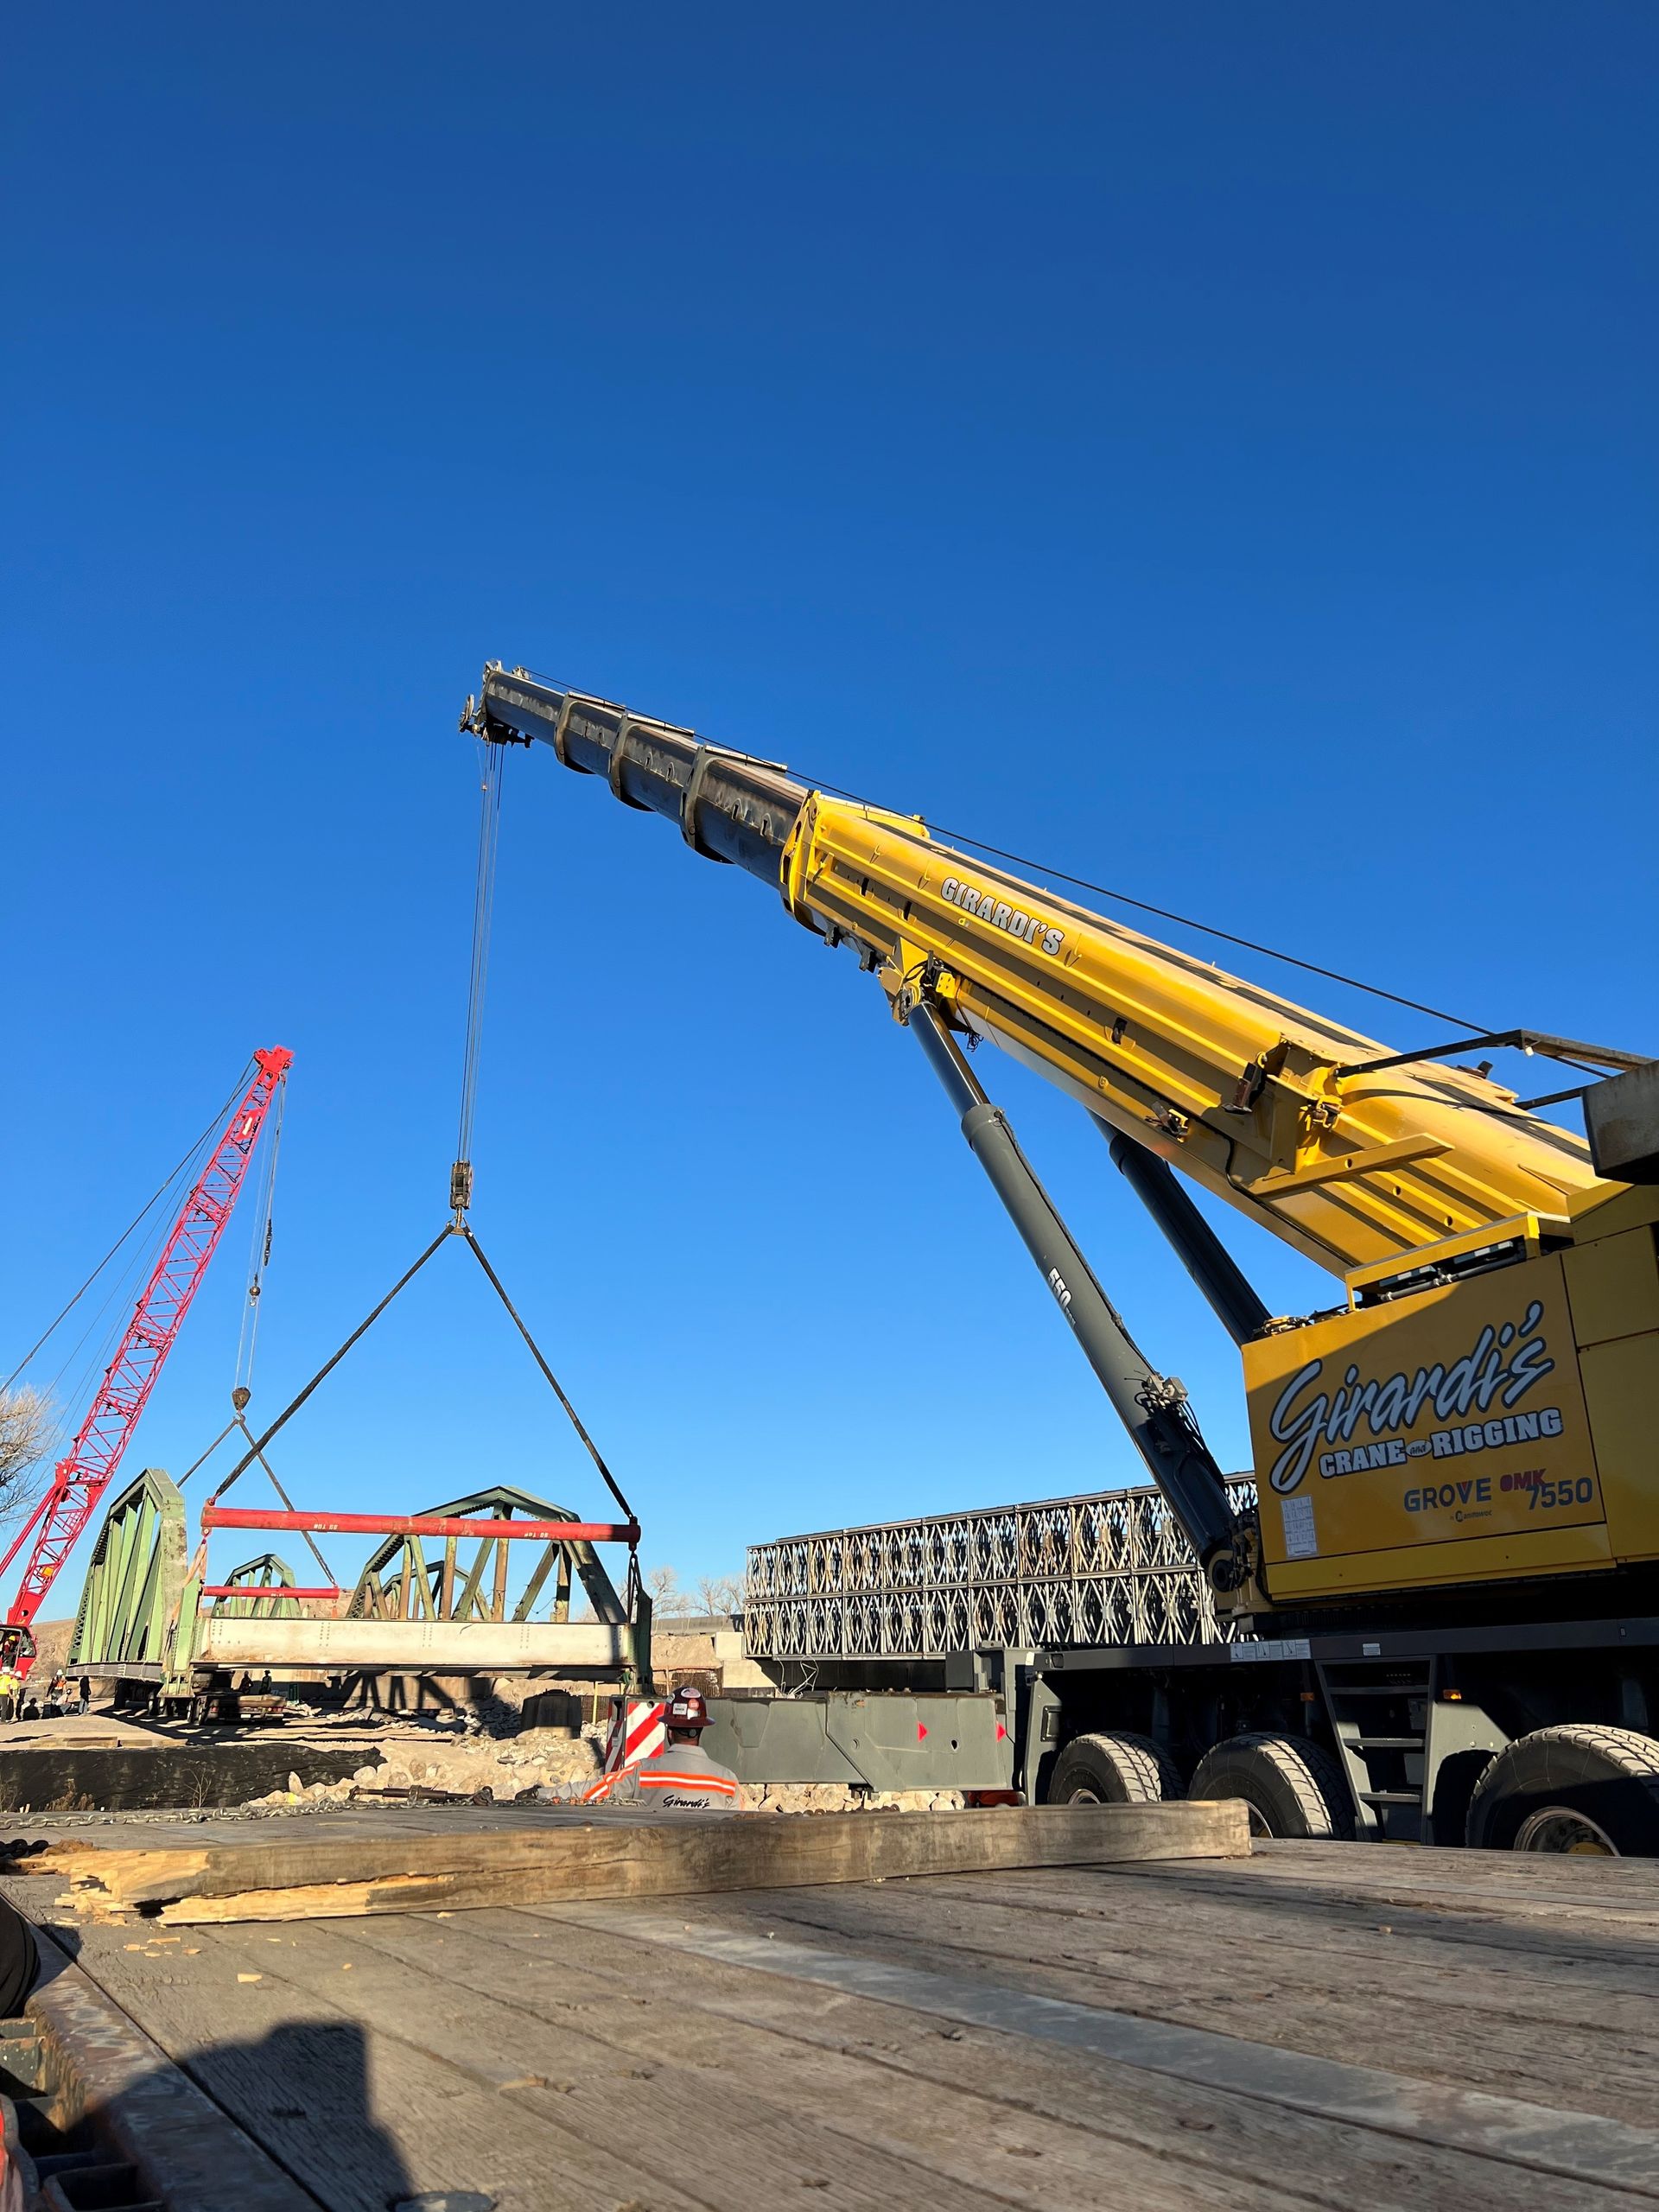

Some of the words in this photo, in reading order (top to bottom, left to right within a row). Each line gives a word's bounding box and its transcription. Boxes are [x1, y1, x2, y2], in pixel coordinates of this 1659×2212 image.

[941, 877, 1065, 956] GIRARDI'S
[1047, 1266, 1072, 1310] 550
[1270, 1300, 1554, 1494] Girardi's
[1319, 1438, 1408, 1478] CRANE
[1430, 1407, 1564, 1459] RIGGING
[1404, 1478, 1491, 1512] GROVE
[1525, 1477, 1592, 1510] 7550
[663, 1794, 710, 1808] Girardi's
